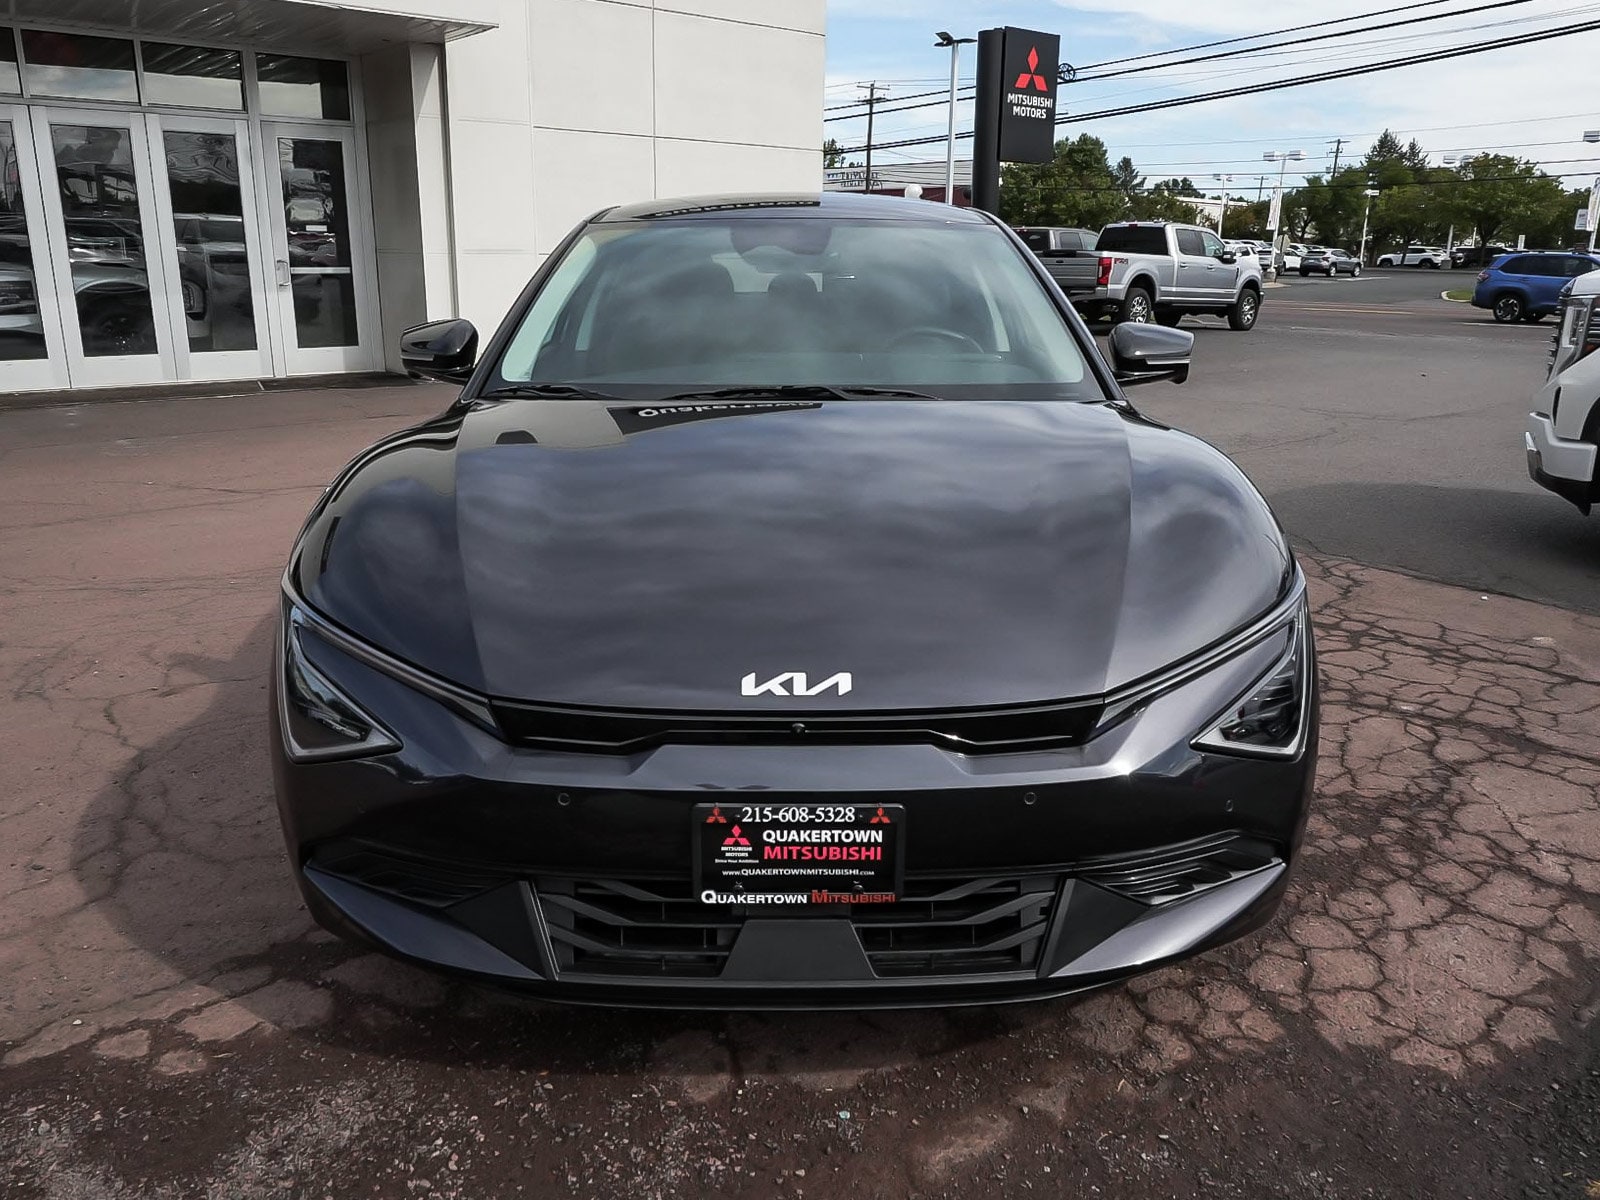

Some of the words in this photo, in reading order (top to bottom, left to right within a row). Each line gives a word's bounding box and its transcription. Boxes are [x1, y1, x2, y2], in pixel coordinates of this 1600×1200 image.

[1007, 92, 1053, 108] MITSUBISHI
[1012, 105, 1047, 119] MOTORS
[741, 672, 852, 696] KIA
[741, 806, 856, 823] 215-608-5328
[762, 829, 883, 844] QUAKERTOWN
[763, 845, 882, 860] MITSUBISHI
